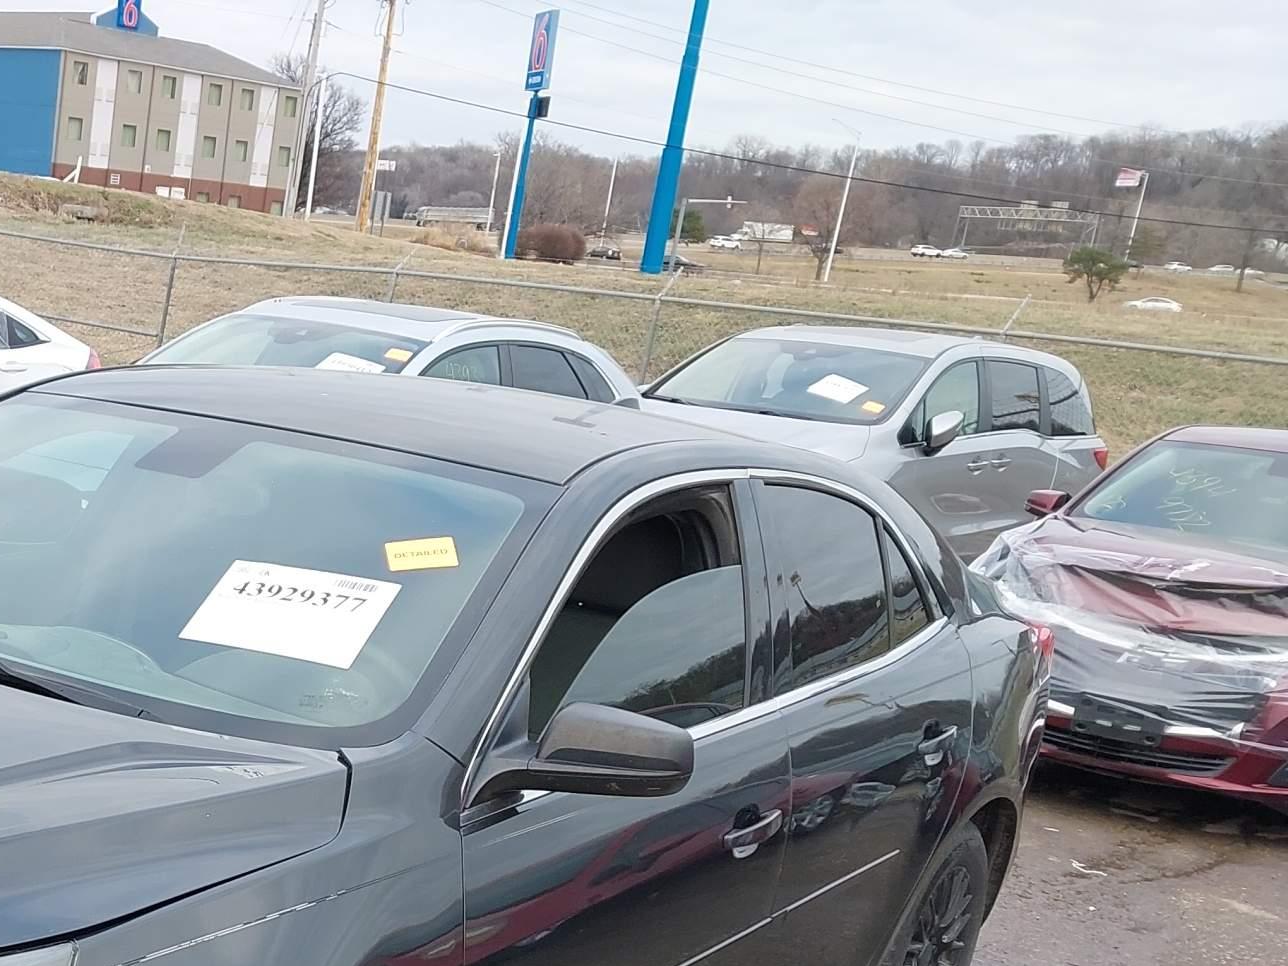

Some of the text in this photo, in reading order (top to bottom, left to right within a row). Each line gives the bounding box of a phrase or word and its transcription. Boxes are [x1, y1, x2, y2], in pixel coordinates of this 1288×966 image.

[123, 0, 138, 27] 6
[531, 13, 549, 70] 6
[393, 546, 449, 560] DETAILED
[232, 580, 369, 612] 43929377
